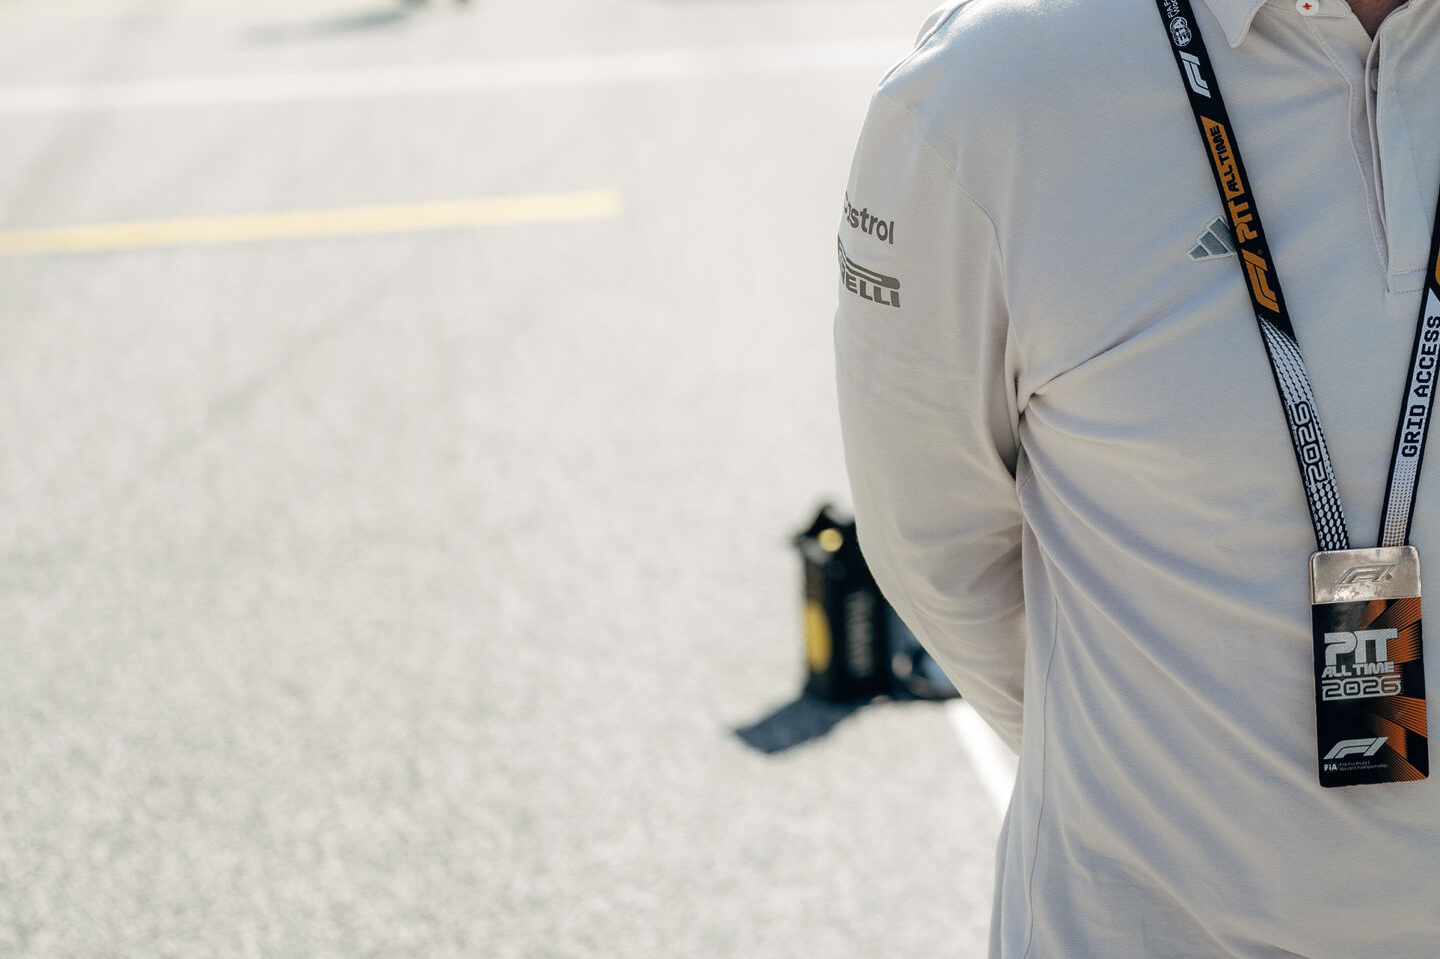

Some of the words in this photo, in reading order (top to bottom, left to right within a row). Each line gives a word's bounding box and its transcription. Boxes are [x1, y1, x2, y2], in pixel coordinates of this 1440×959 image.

[1209, 125, 1230, 166] TIME
[1224, 164, 1240, 192] ALL
[843, 193, 895, 245] strol
[1227, 199, 1258, 243] PIT
[1289, 401, 1328, 487] 2026
[1401, 404, 1426, 458] GRID
[1324, 628, 1398, 666] PIT
[1321, 665, 1352, 679] ALL
[1352, 661, 1395, 676] TIME
[1321, 675, 1401, 701] 2026
